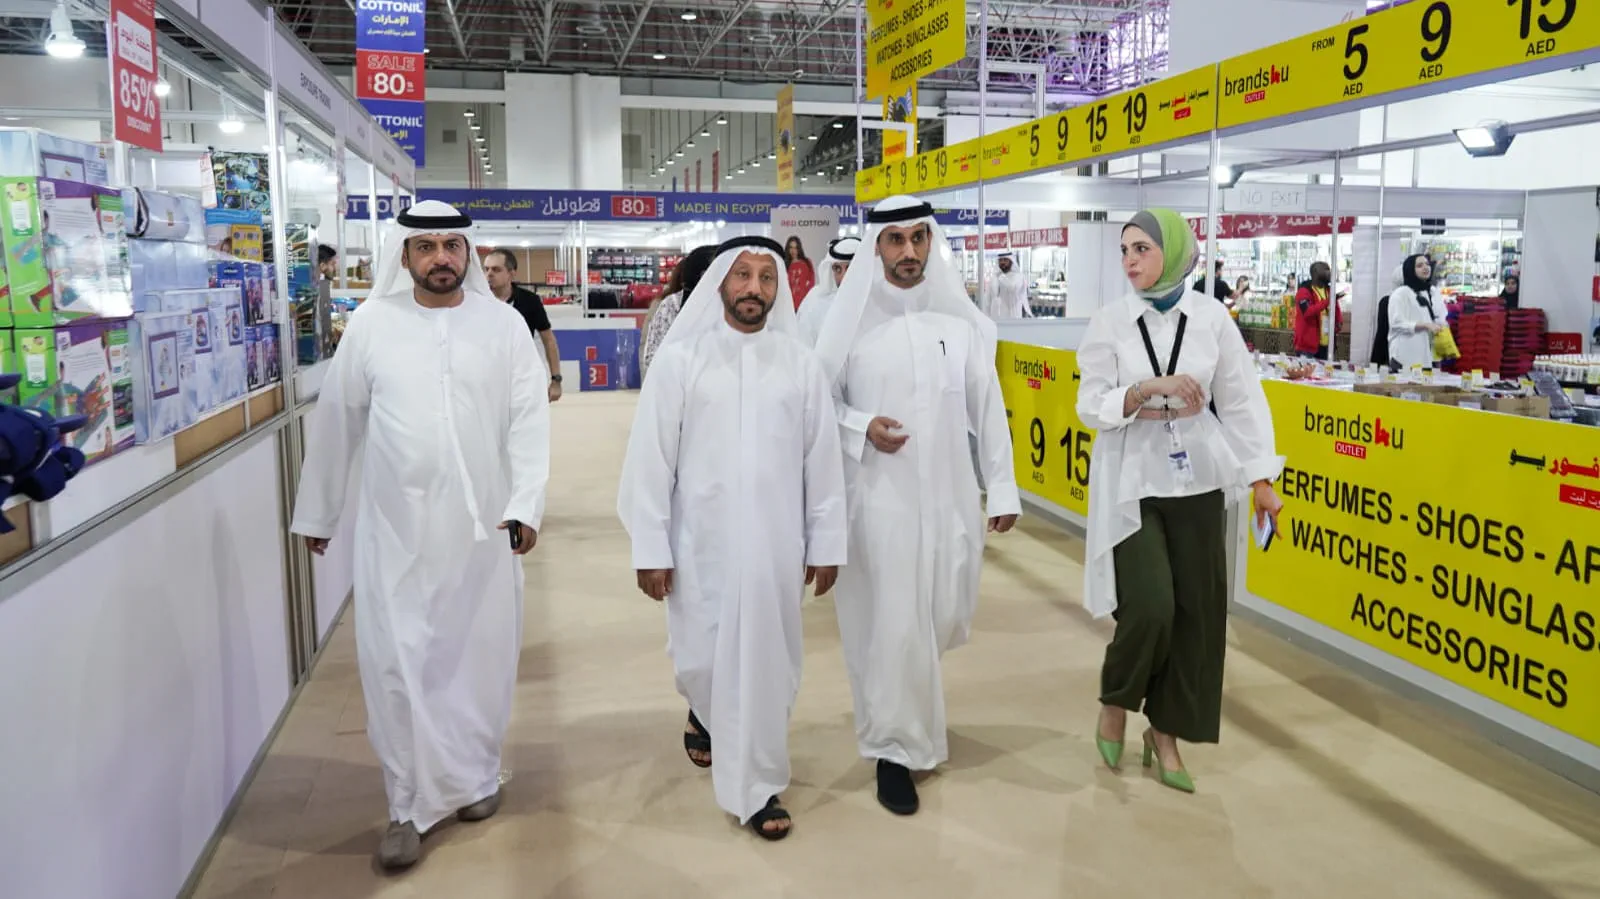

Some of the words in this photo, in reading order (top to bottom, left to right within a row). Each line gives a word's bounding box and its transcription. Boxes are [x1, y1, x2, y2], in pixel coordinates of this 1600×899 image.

[358, 0, 424, 13] COTTONIL
[1420, 1, 1452, 62] 9
[1507, 0, 1577, 40] 15
[876, 38, 902, 64] WATCHES
[906, 11, 949, 49] SUNGLASSES
[1311, 36, 1335, 52] FROM
[1525, 38, 1556, 57] AED
[367, 54, 416, 72] SALE
[1343, 24, 1369, 80] 5
[890, 49, 932, 83] ACCESSORIES
[1418, 64, 1443, 80] AED
[120, 68, 155, 120] 85%
[374, 72, 406, 95] 80
[1343, 82, 1363, 97] AED
[1245, 91, 1265, 103] OUTLET
[372, 114, 423, 127] TTONIL
[1086, 104, 1107, 143] 15
[1123, 92, 1147, 134] 19
[1030, 124, 1040, 157] 5
[1058, 116, 1068, 151] 9
[1130, 135, 1141, 144] AED
[901, 161, 907, 185] 9
[916, 156, 928, 182] 15
[935, 150, 947, 178] 19
[885, 164, 892, 189] 5
[622, 199, 644, 215] 80
[674, 202, 712, 214] MADE
[716, 203, 728, 214] IN
[732, 203, 770, 214] EGYPT
[1240, 189, 1263, 205] NO
[1269, 215, 1279, 229] 2
[1030, 417, 1046, 468] 9
[1336, 442, 1365, 457] OUTLET
[1060, 426, 1092, 487] 15
[1508, 448, 1546, 472] يو
[1032, 471, 1044, 484] AED
[1070, 487, 1084, 501] AED
[1416, 501, 1525, 564] SHOES
[1291, 517, 1407, 585] WATCHES
[1431, 564, 1600, 652] SUNGLAS
[1350, 592, 1569, 709] ACCESSORIES
